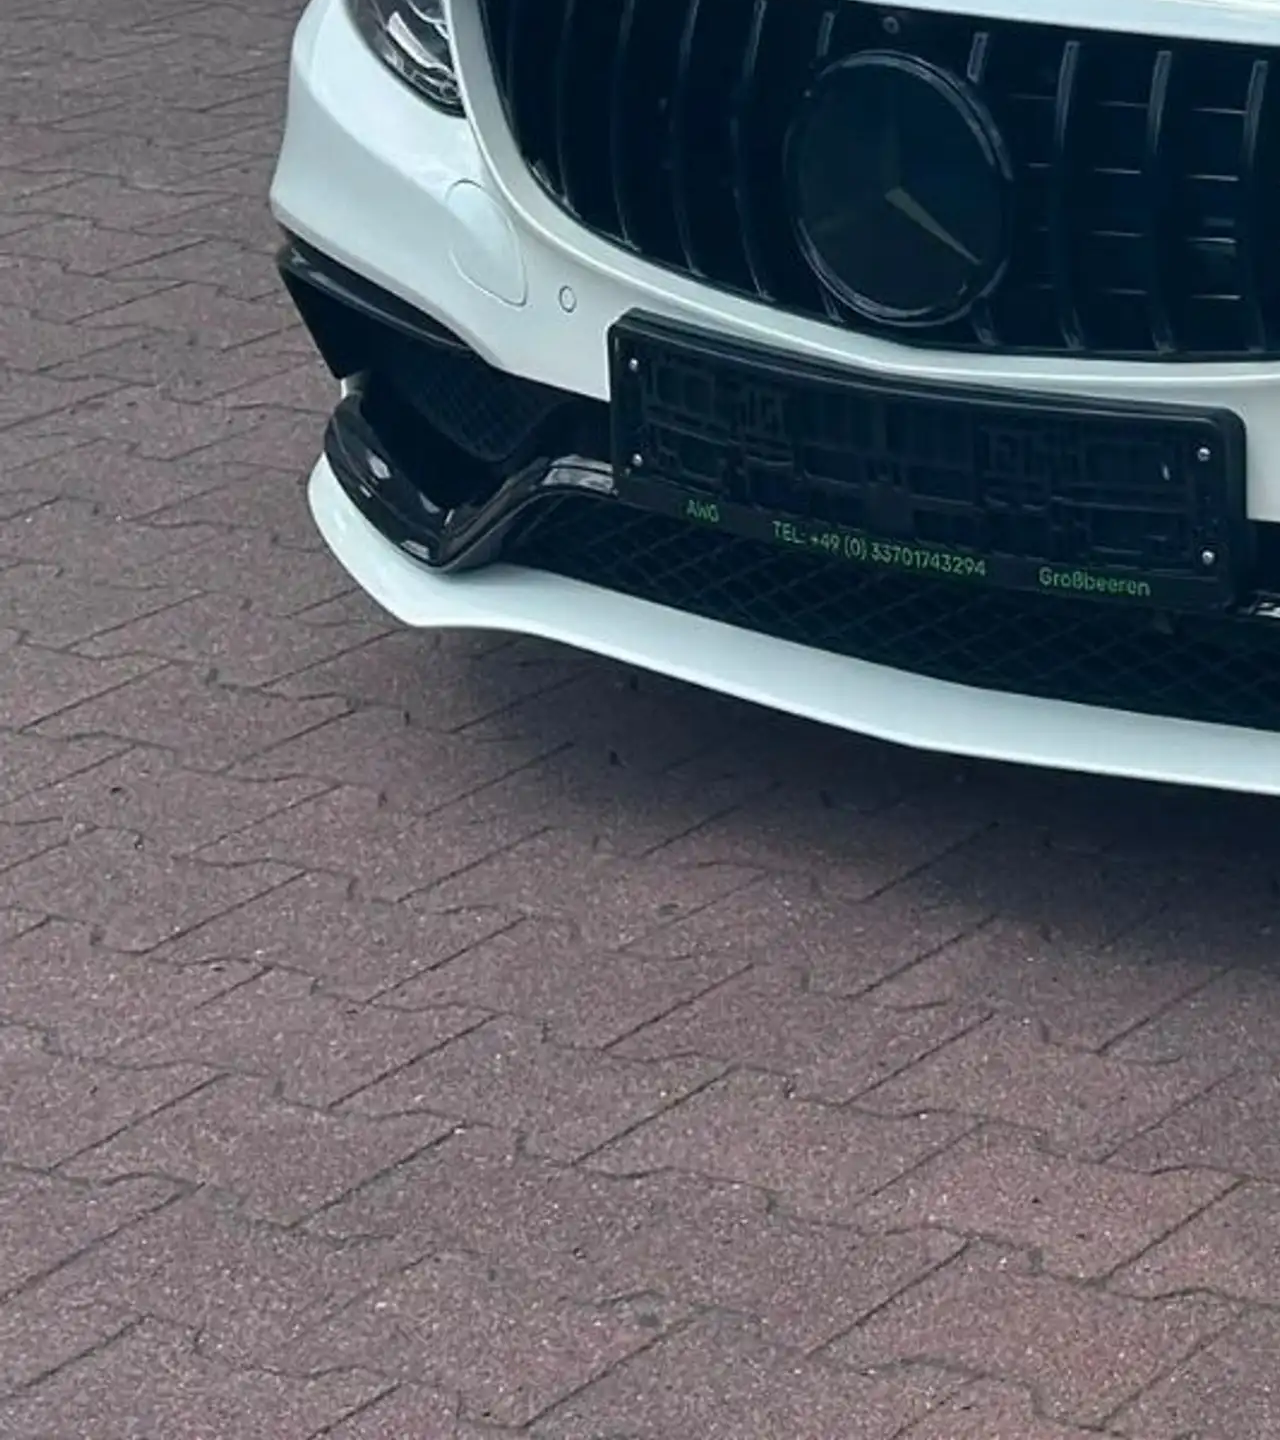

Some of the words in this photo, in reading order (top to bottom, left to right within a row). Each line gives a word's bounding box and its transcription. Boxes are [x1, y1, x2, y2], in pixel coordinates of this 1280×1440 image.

[810, 533, 841, 550] +49
[844, 535, 867, 560] (0)
[1038, 565, 1152, 597] Großbeeren
